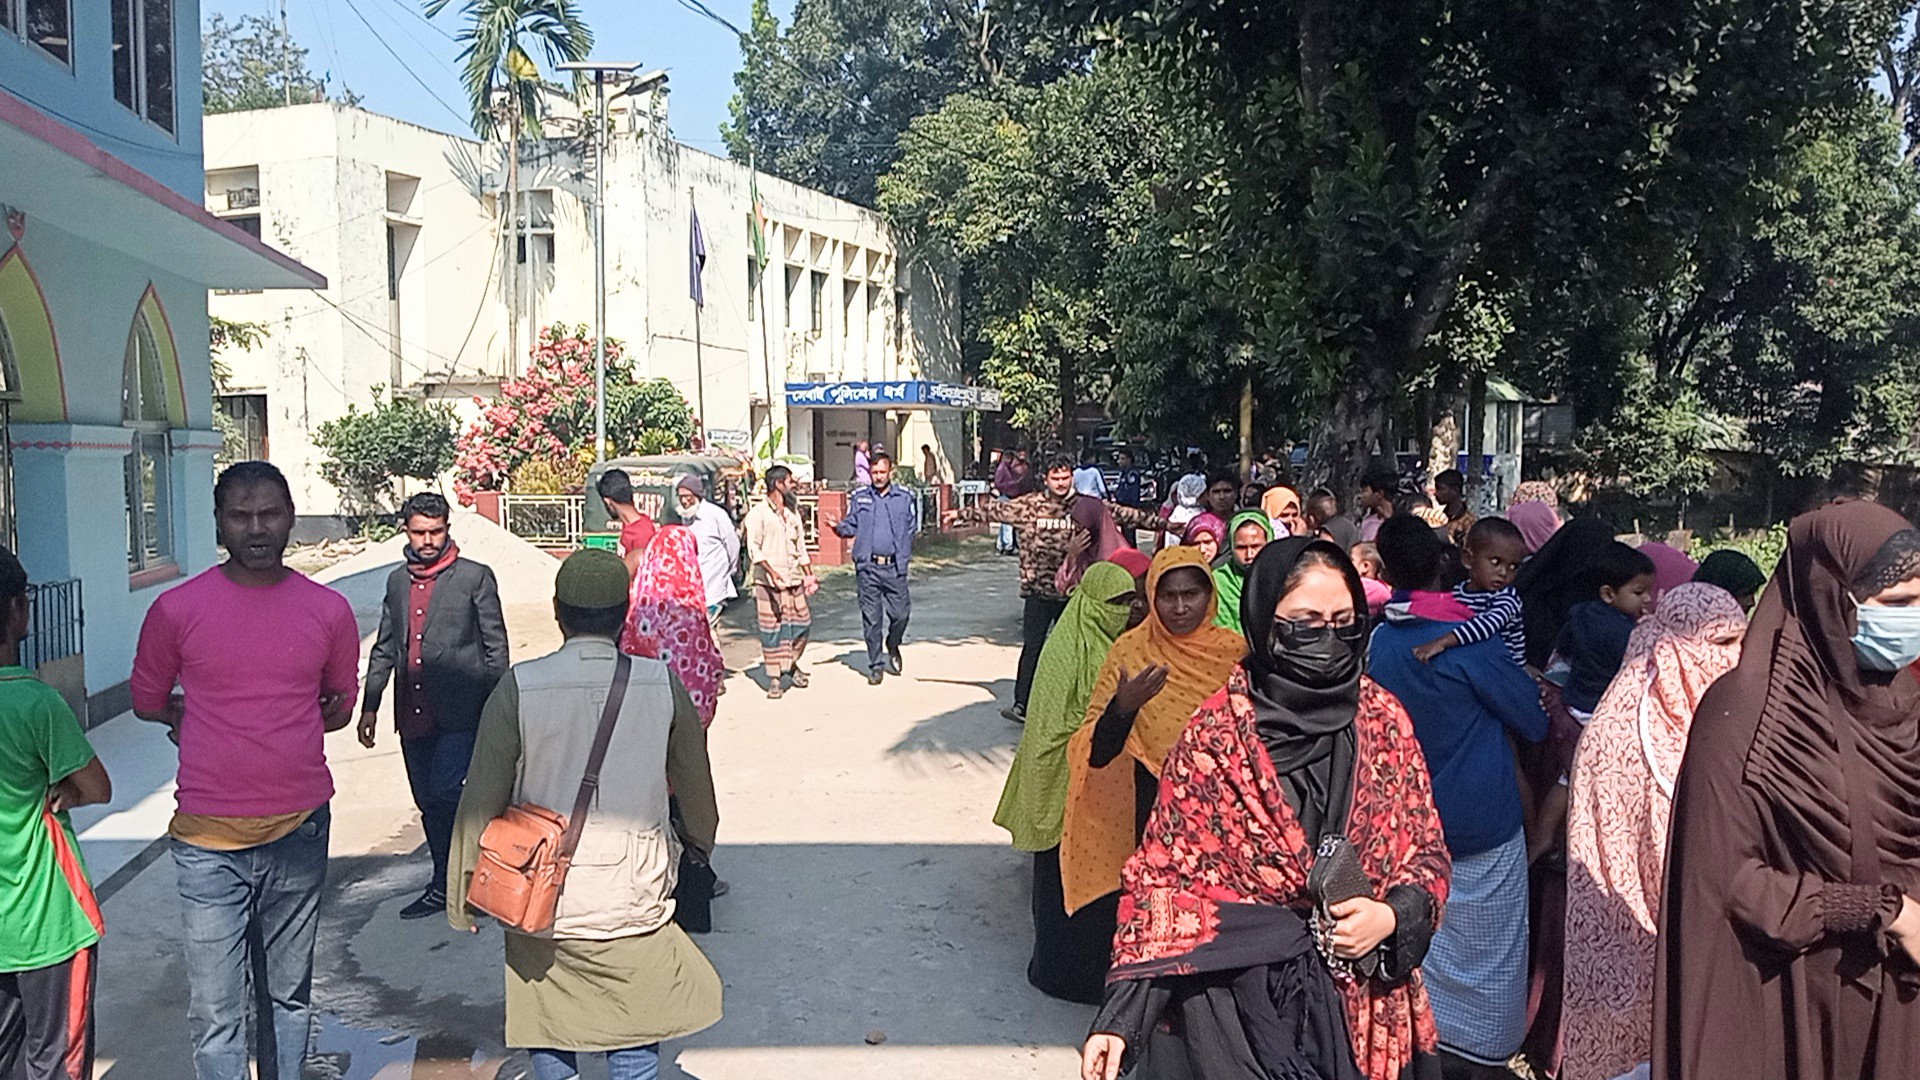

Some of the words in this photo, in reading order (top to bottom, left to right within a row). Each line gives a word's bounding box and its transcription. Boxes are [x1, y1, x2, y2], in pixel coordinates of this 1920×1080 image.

[830, 384, 878, 405] পুলিশের
[883, 384, 906, 400] ধর্ম
[1036, 513, 1075, 530] mysel
